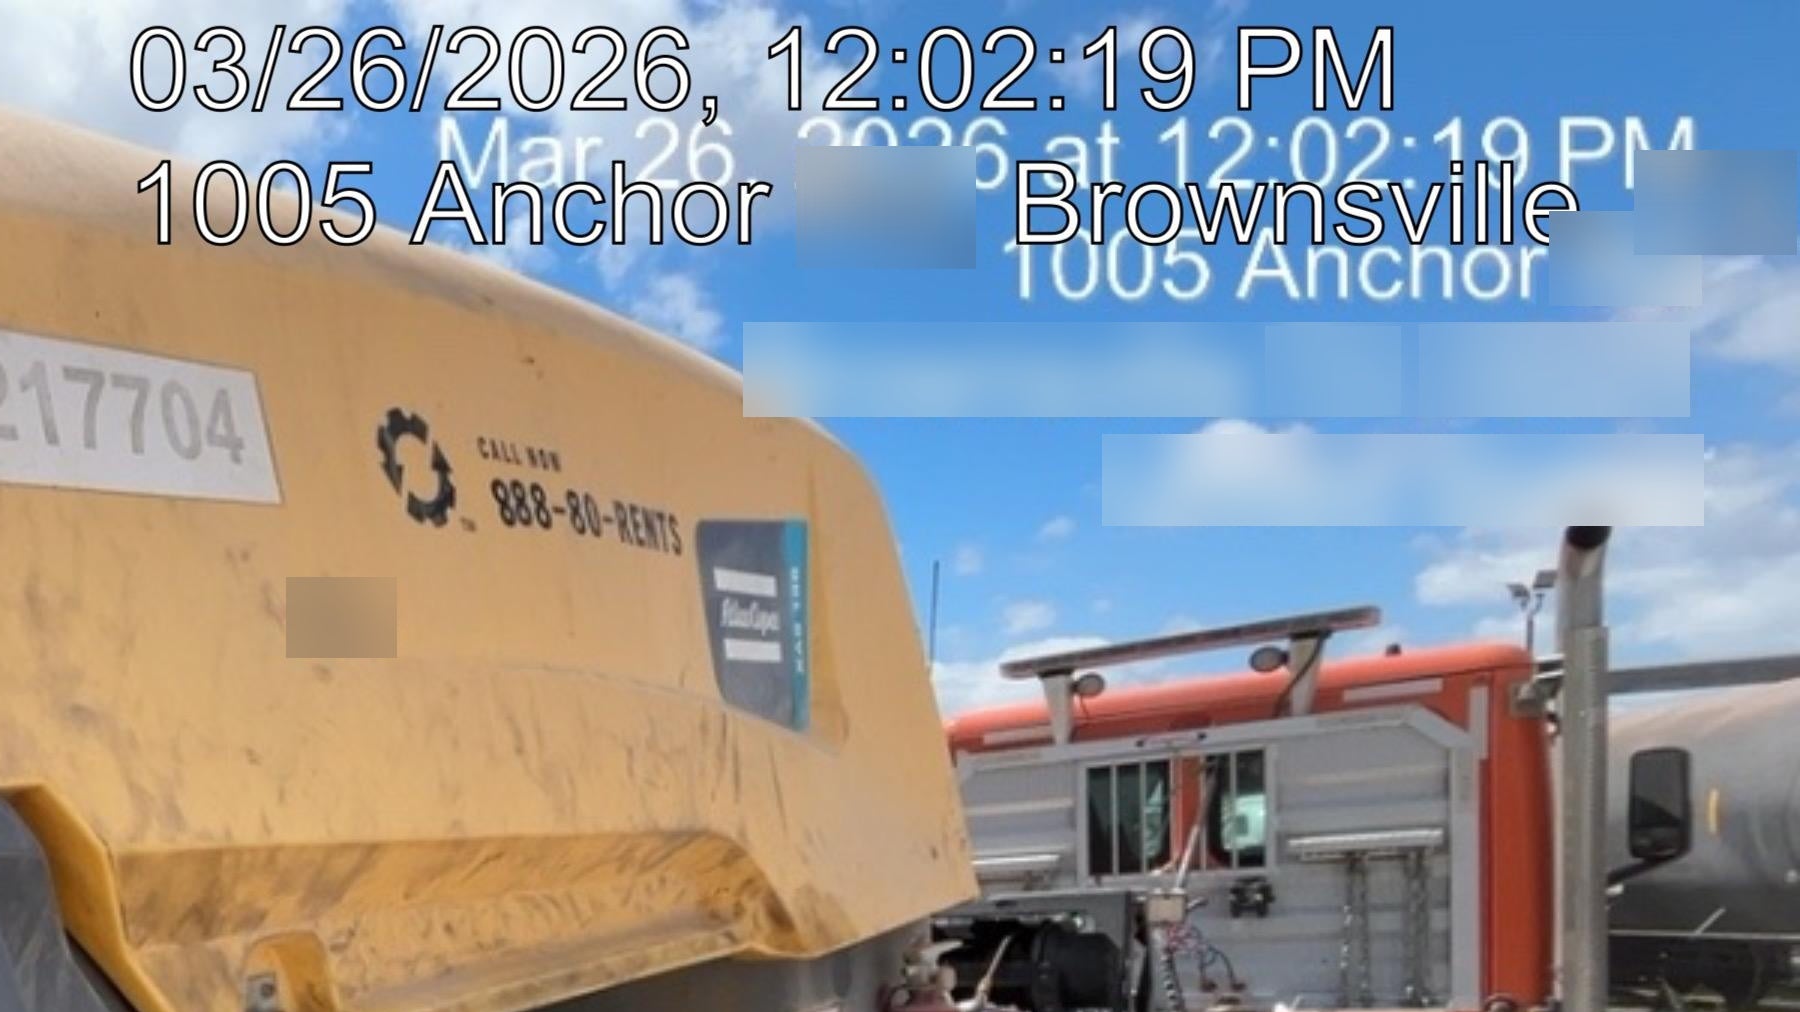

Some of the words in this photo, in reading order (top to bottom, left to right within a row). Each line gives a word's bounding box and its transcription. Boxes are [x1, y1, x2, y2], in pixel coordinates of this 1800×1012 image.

[476, 435, 522, 466] CALL
[525, 446, 562, 473] NOW
[490, 477, 683, 557] 888-80-RENTS
